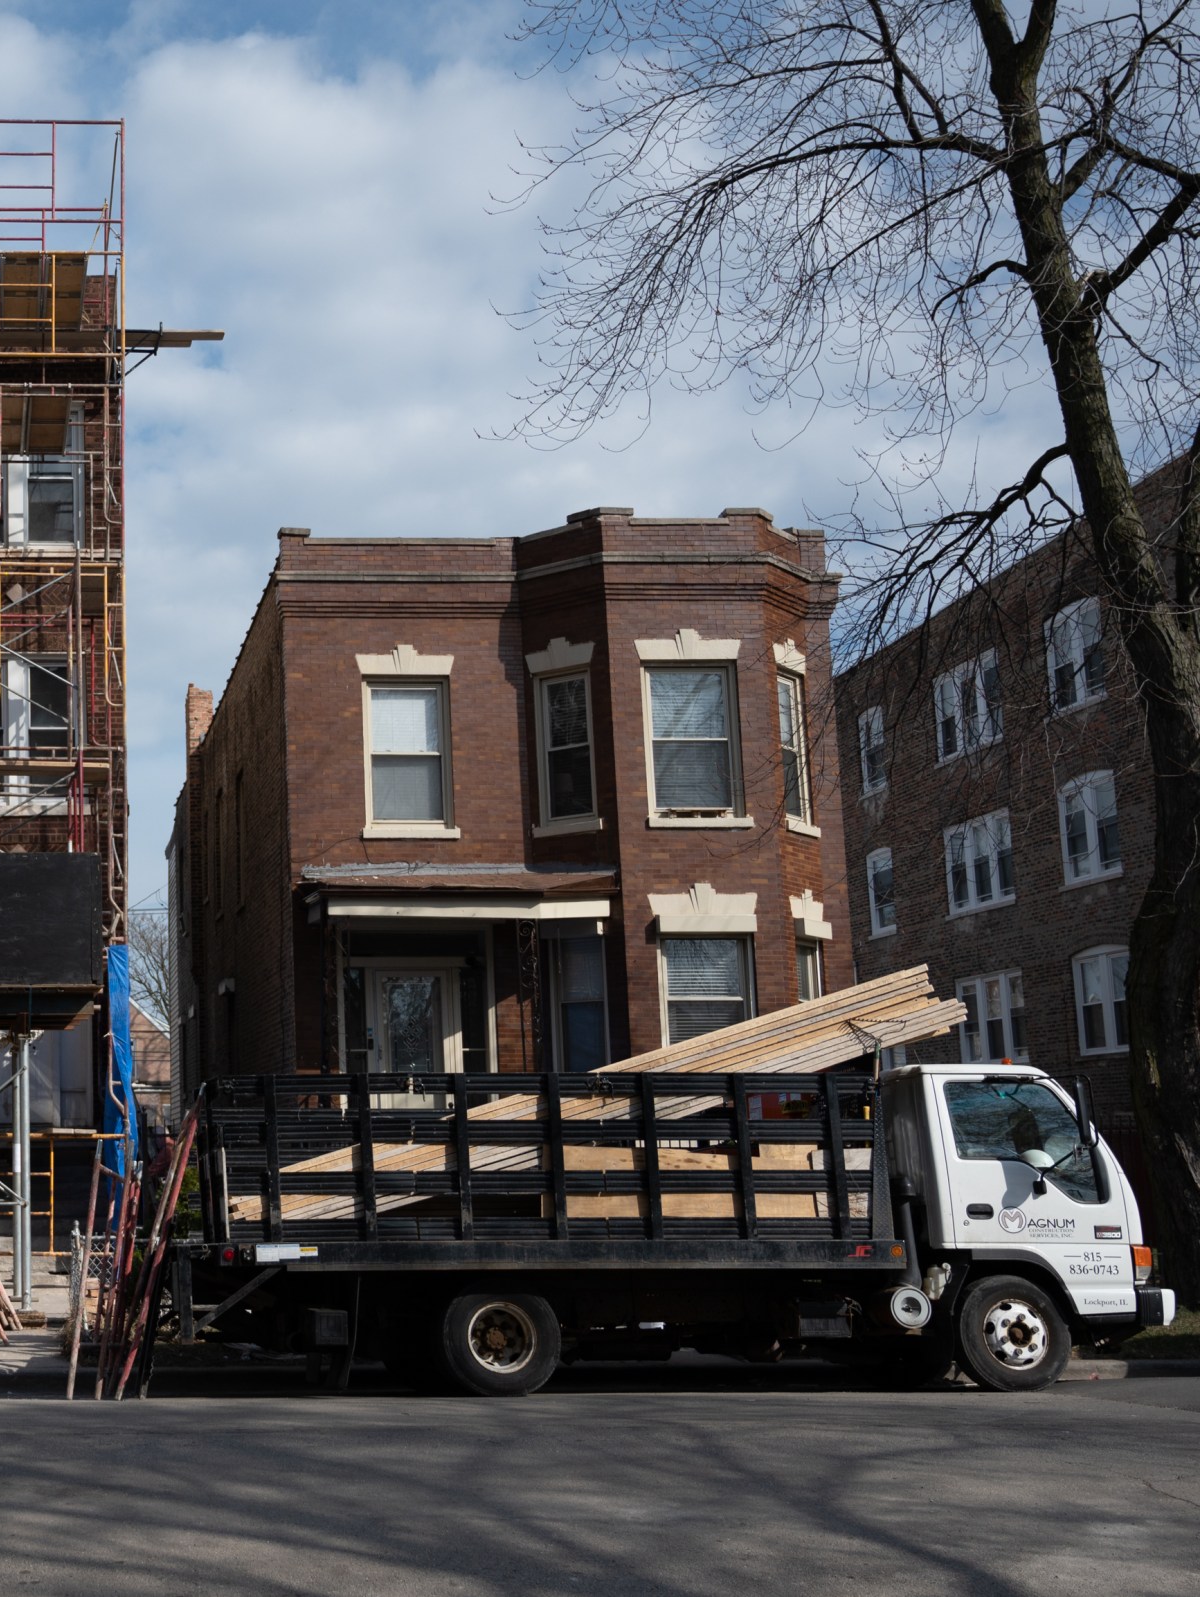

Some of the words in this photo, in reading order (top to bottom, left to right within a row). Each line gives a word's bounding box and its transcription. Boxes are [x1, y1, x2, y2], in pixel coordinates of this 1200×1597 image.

[1083, 1252, 1102, 1262] 815
[1069, 1264, 1120, 1276] 836-0743
[1084, 1298, 1118, 1308] Lockport,
